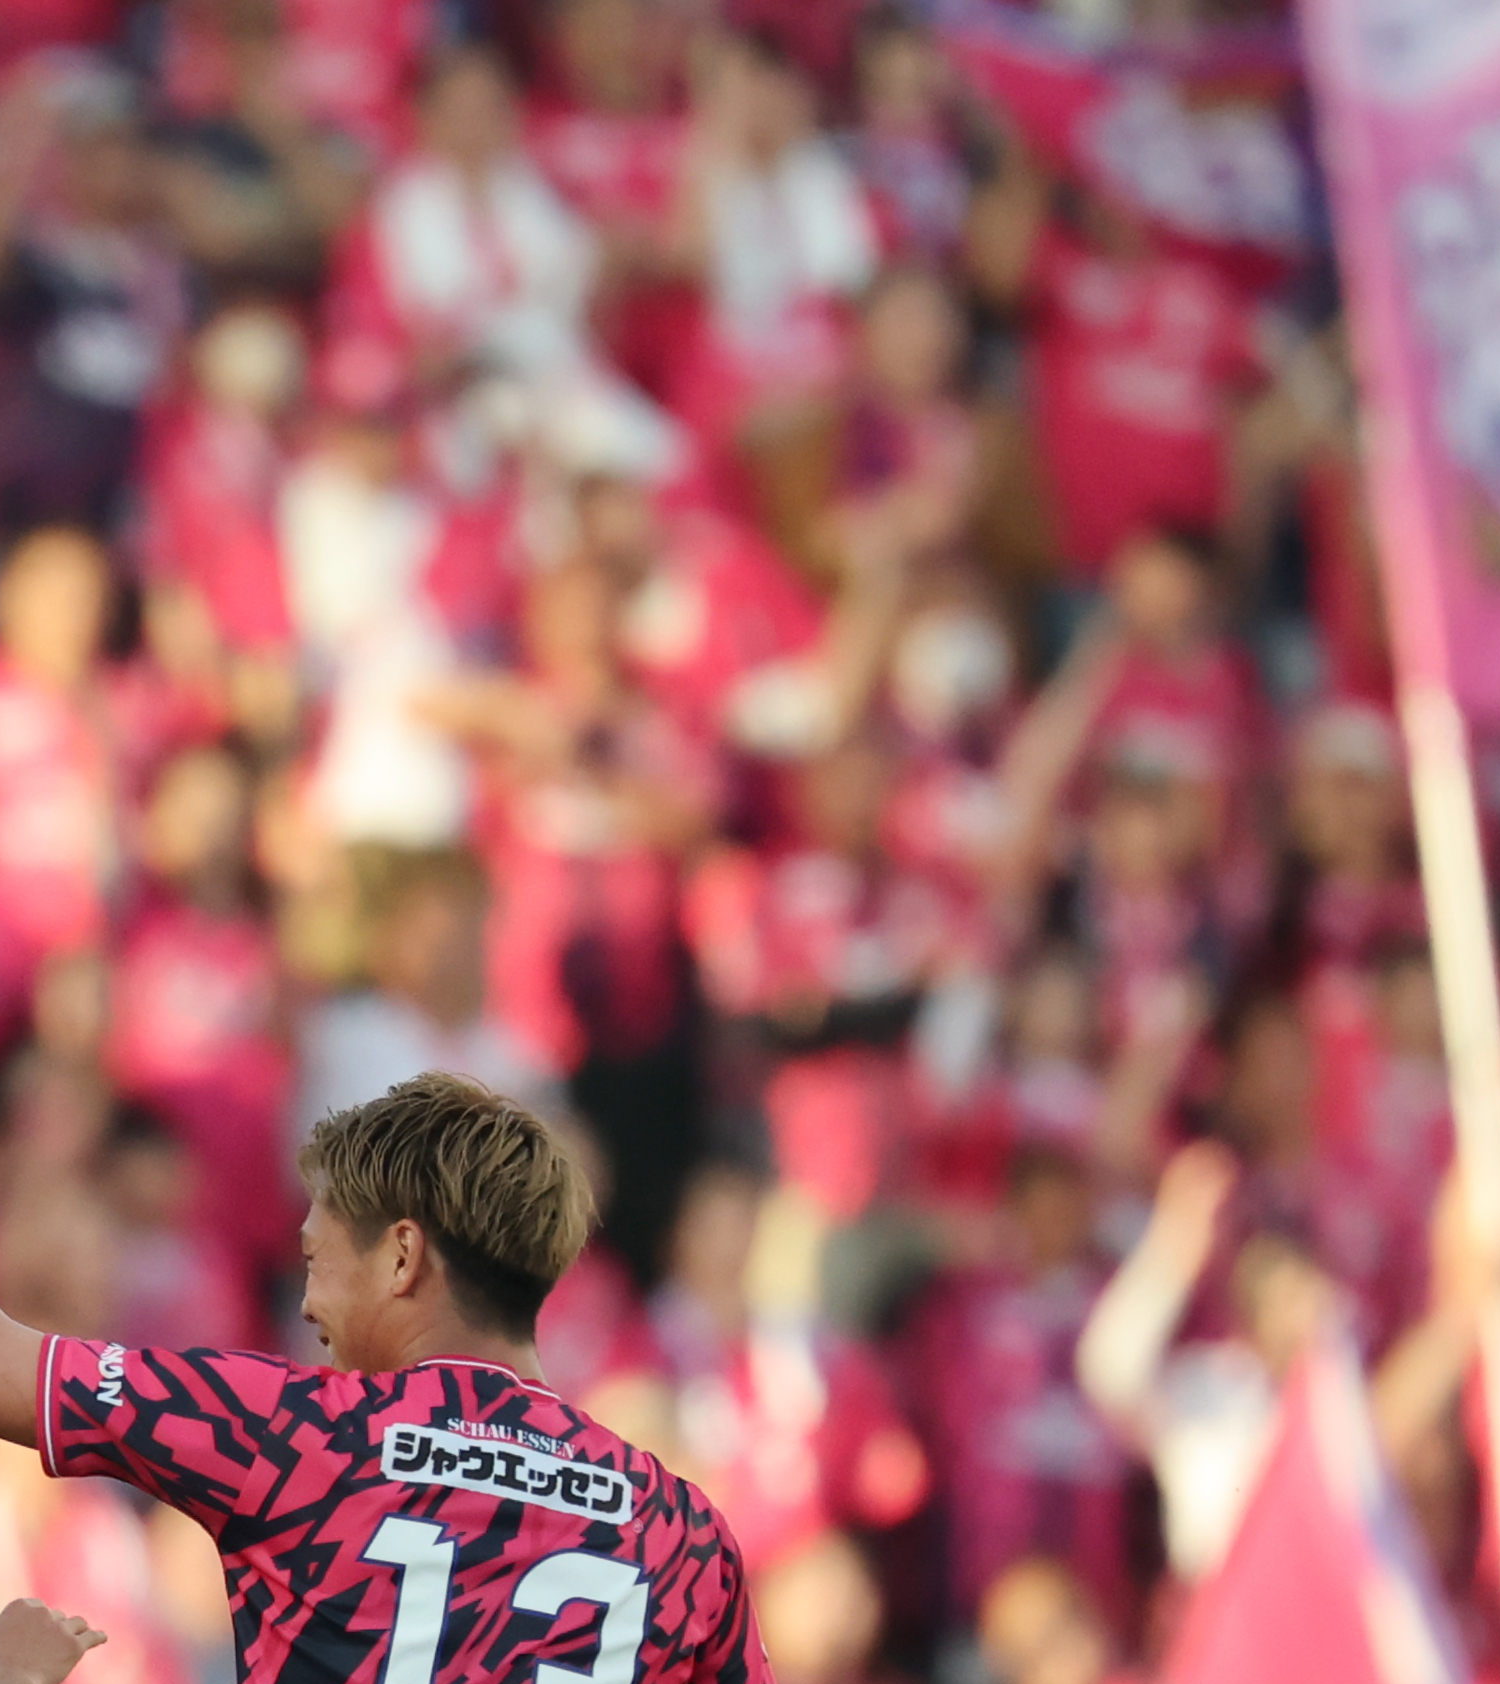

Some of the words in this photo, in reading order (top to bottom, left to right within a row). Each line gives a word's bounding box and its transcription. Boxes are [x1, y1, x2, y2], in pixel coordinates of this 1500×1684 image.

[446, 1416, 512, 1441] SCHAU
[516, 1428, 575, 1460] ESSEN
[392, 1431, 625, 1514] シャウエッセン
